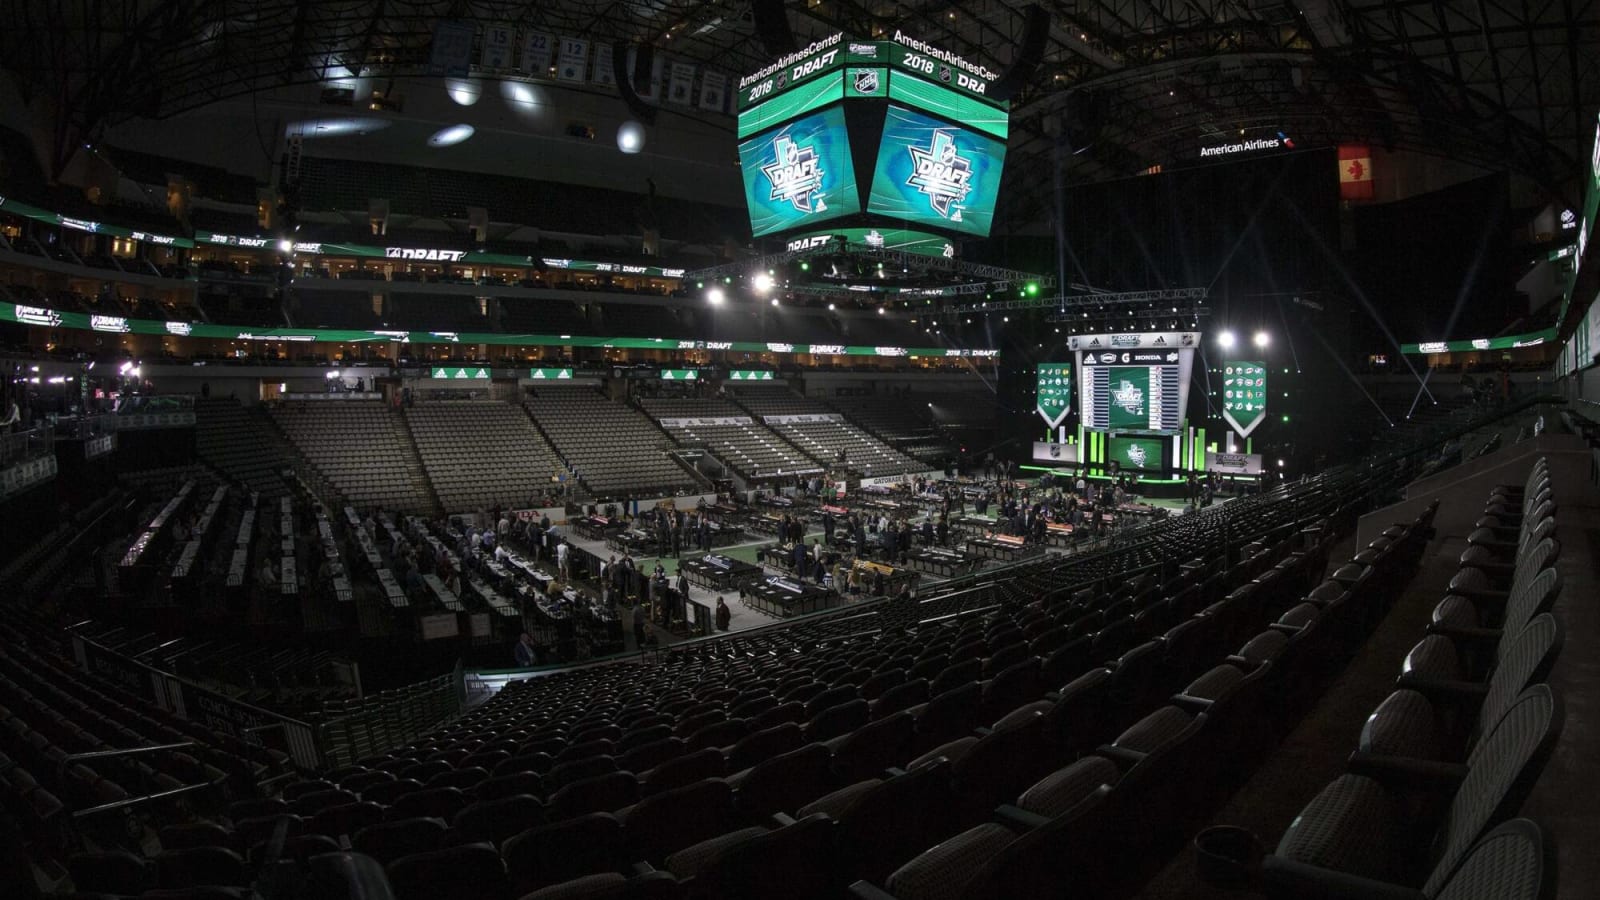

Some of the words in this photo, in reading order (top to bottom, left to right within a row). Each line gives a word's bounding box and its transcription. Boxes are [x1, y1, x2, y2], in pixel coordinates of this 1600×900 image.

[493, 30, 507, 44] 15
[532, 35, 546, 49] 22
[567, 42, 582, 55] 12
[739, 32, 843, 89] AmericanAirlinesCenter
[749, 80, 773, 101] 2018
[792, 49, 839, 81] DRAFT
[903, 52, 934, 74] 2018
[957, 72, 986, 95] DRA
[1200, 143, 1243, 157] American
[1244, 138, 1279, 151] Airlines
[773, 159, 819, 187] DRAFT
[918, 159, 971, 185] DRAFT
[152, 235, 175, 244] DRAFT
[210, 234, 228, 243] 2018
[239, 238, 267, 247] DRAFT
[402, 249, 464, 262] DRAFT
[596, 263, 612, 271] 2018
[622, 265, 647, 273] DRAFT
[678, 341, 695, 349] 2018
[706, 342, 732, 350] DRAFT
[816, 345, 842, 353] DRAFT
